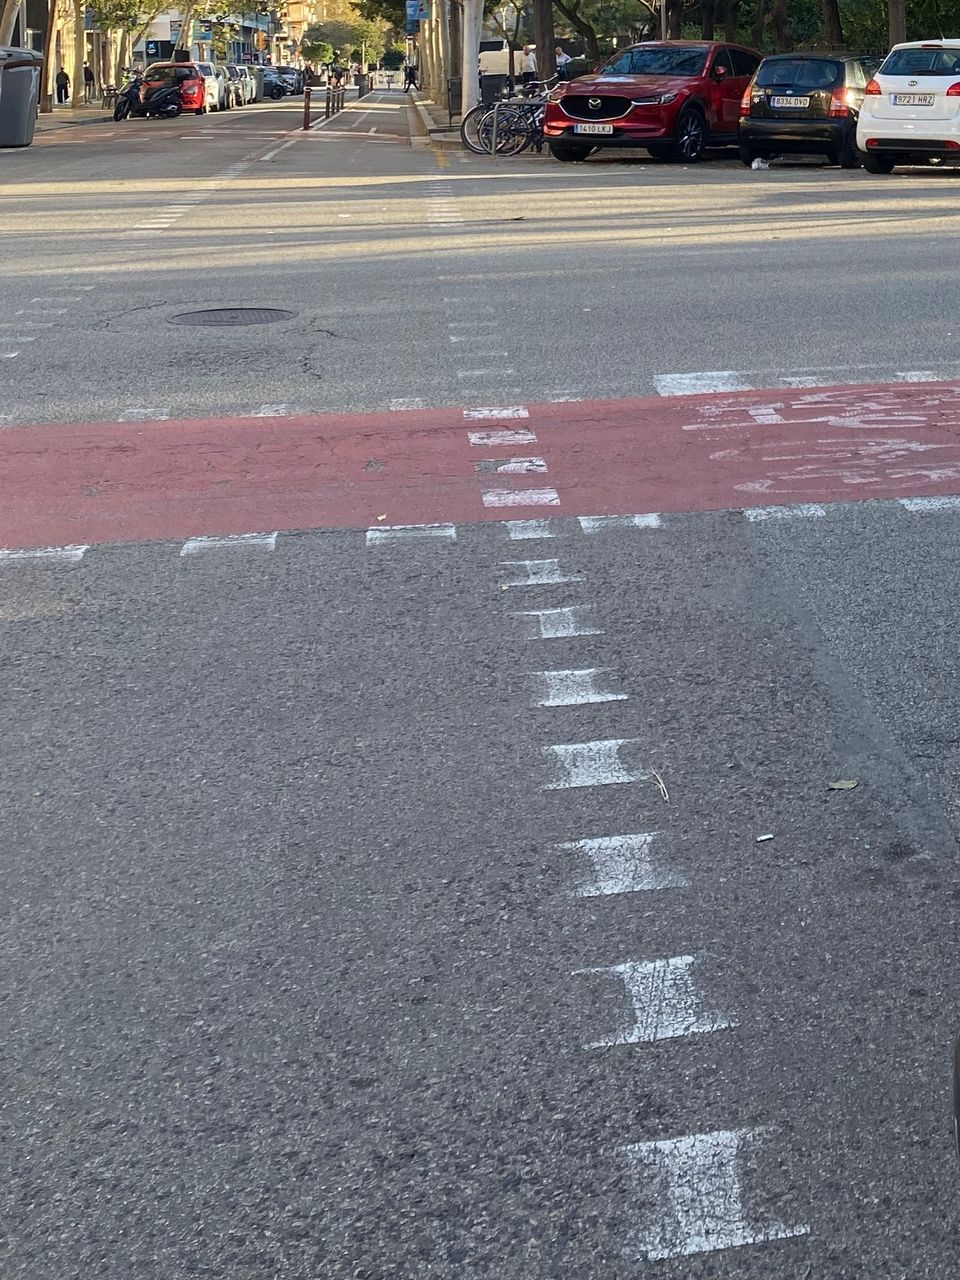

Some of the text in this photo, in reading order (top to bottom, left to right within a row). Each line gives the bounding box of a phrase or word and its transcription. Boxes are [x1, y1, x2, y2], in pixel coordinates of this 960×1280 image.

[776, 97, 792, 106] 8334
[897, 95, 933, 104] 9721 HRZ
[579, 124, 611, 133] 1410 LKJ
